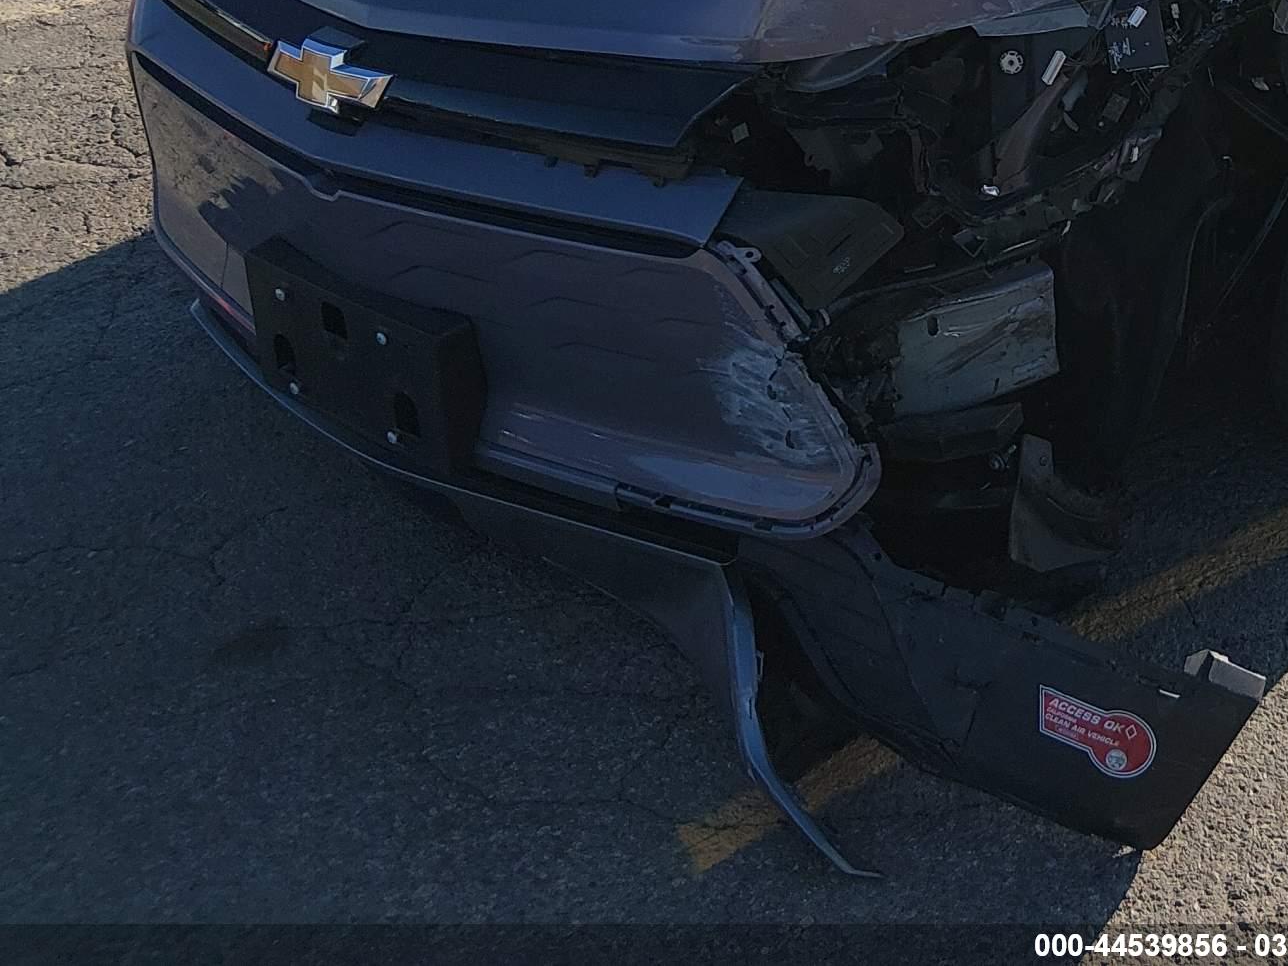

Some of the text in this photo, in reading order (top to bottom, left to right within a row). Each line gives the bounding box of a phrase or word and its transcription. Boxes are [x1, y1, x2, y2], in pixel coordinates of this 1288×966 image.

[1044, 713, 1071, 728] CLEAN
[1071, 724, 1086, 735] AIR
[1087, 730, 1120, 747] VEHICLE
[1049, 697, 1101, 725] ACCESS
[1104, 719, 1125, 733] OK
